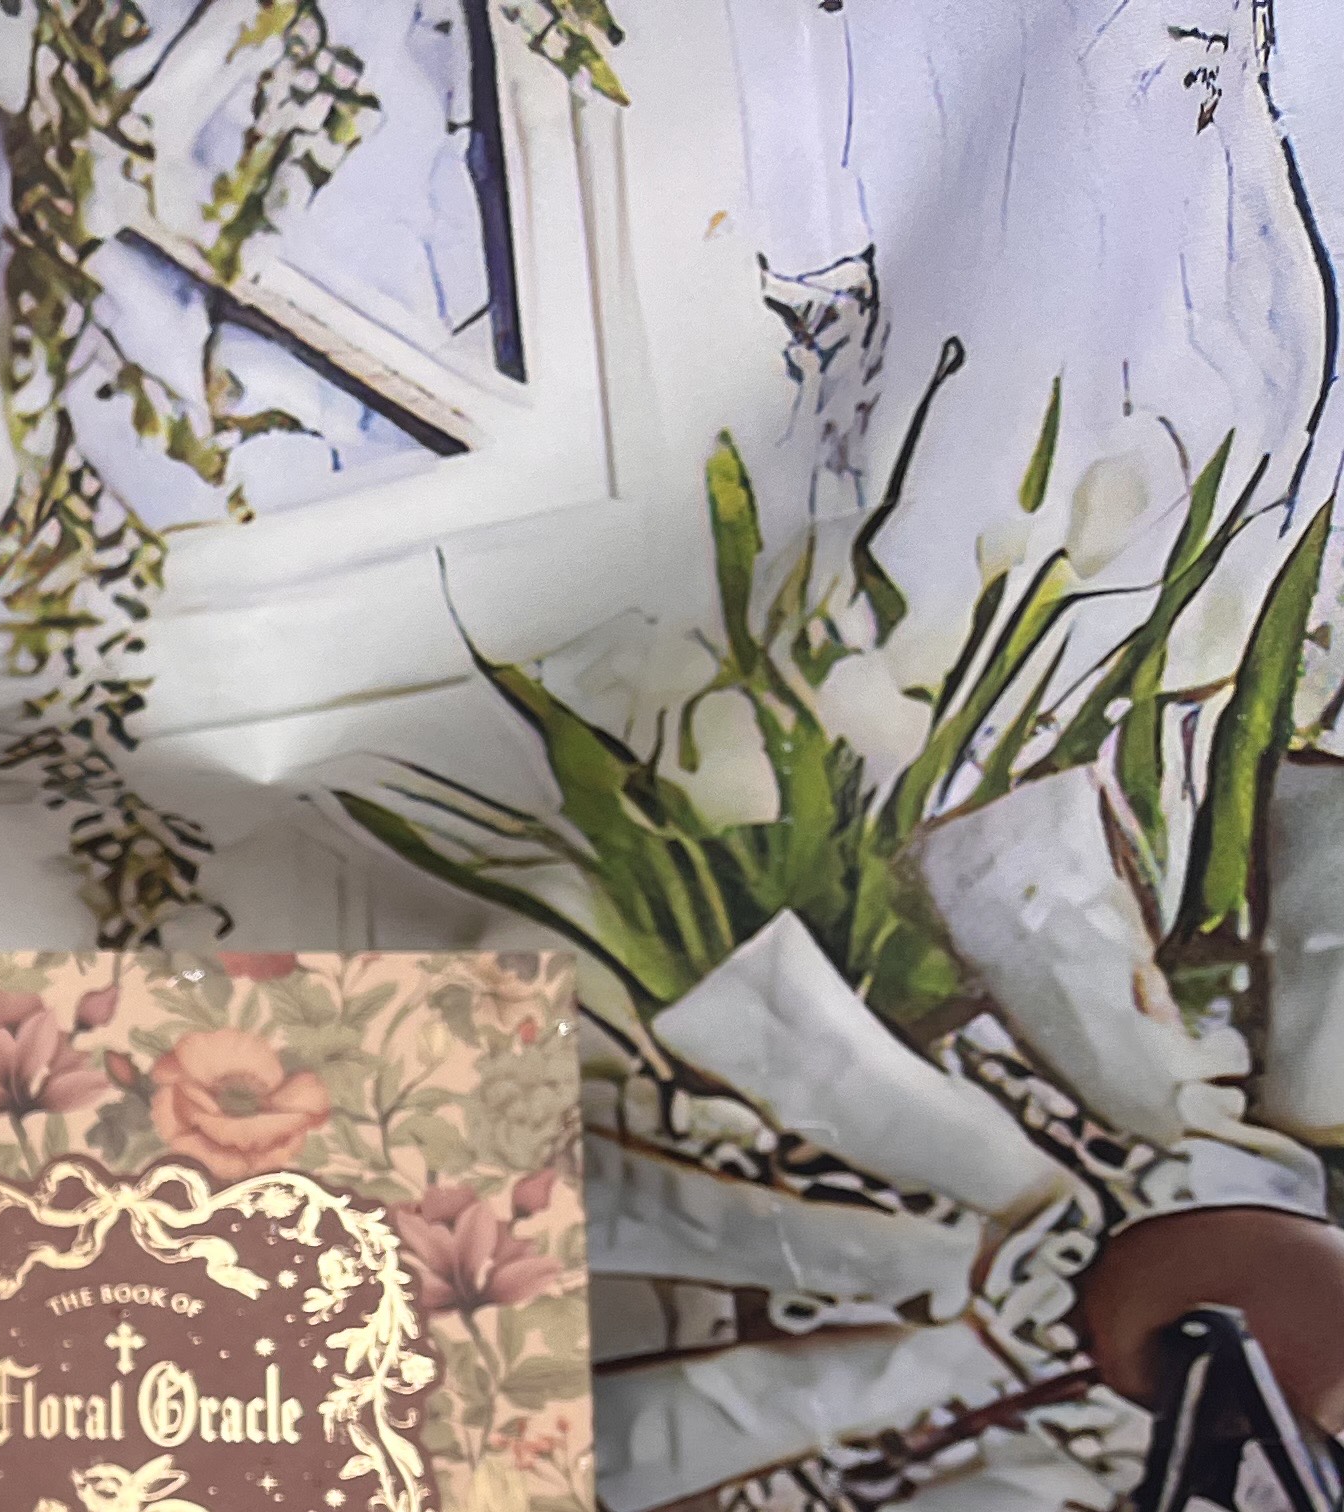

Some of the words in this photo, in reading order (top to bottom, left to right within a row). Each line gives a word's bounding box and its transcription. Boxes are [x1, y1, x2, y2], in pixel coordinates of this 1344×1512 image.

[46, 1286, 94, 1317] THE
[101, 1283, 169, 1308] BOOK
[171, 1293, 204, 1318] OF
[137, 1360, 305, 1448] Oracle
